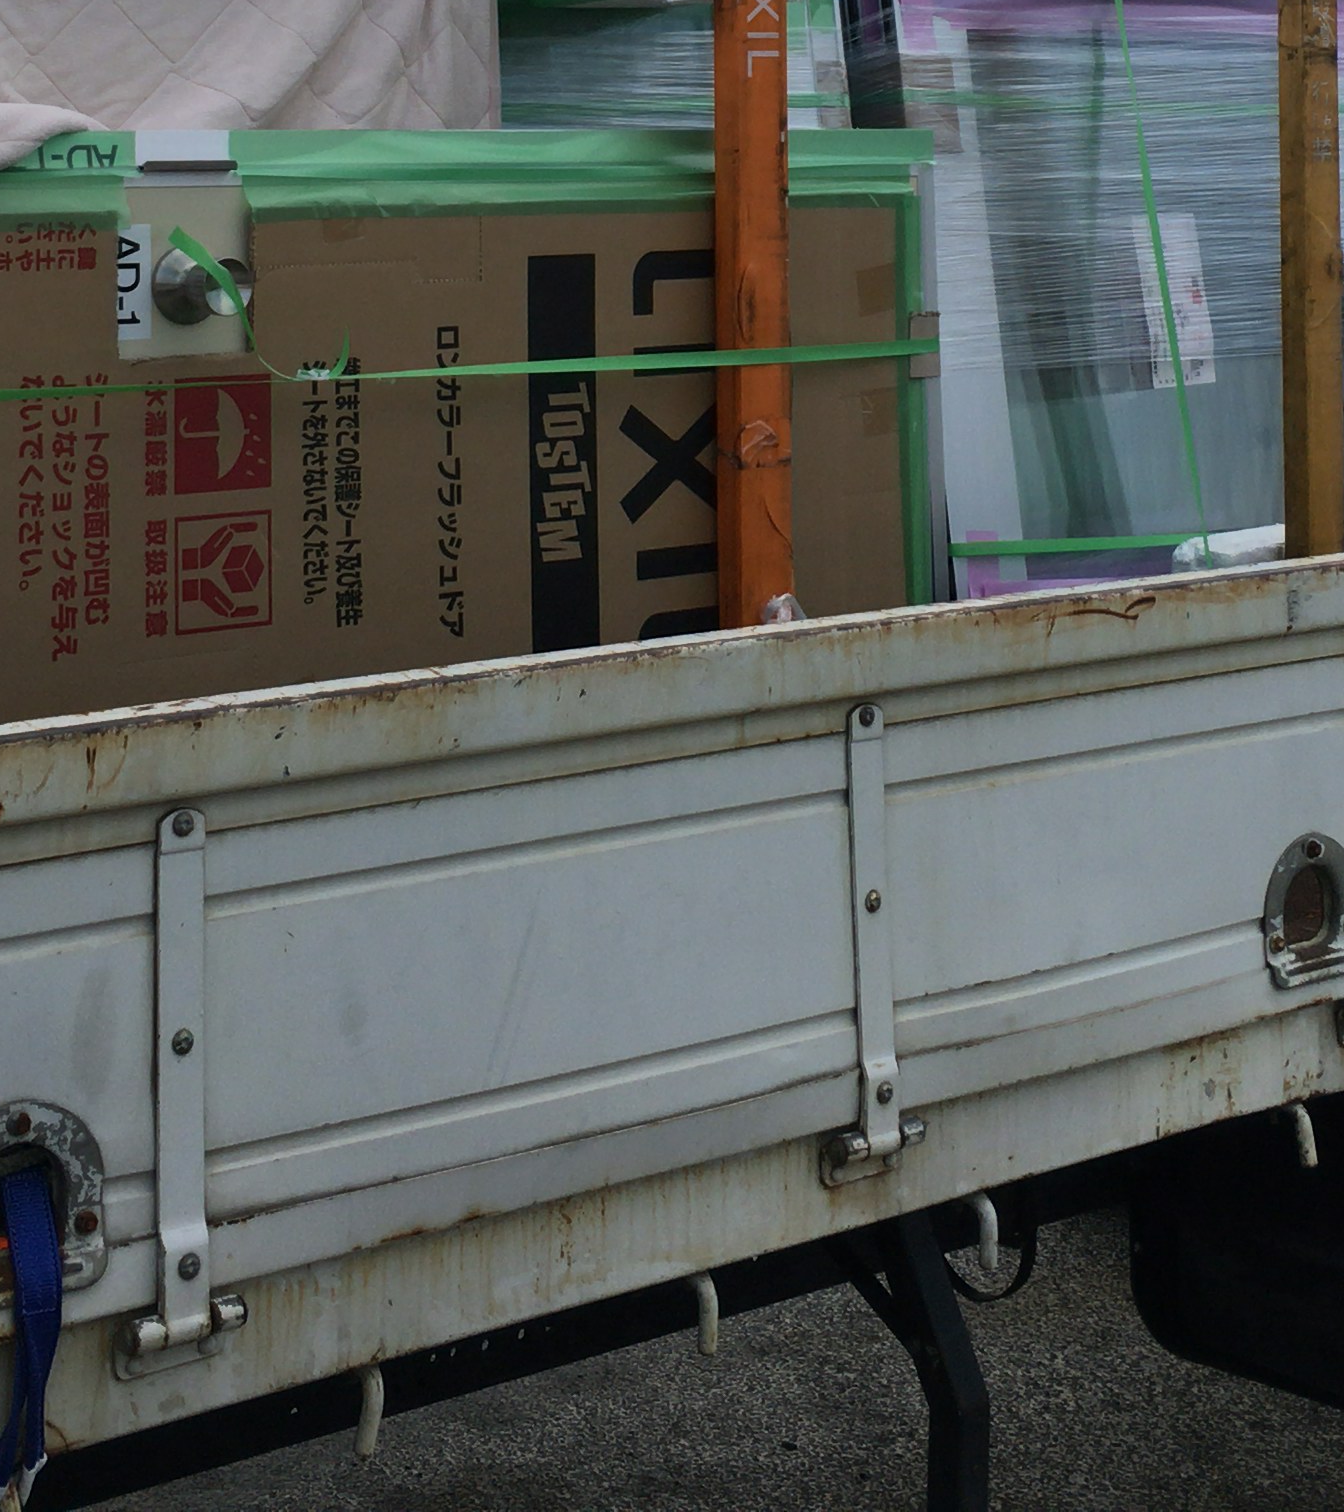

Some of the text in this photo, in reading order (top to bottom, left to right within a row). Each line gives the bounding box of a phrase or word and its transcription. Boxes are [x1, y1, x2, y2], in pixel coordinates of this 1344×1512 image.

[83, 372, 111, 626] シートの表面が凹む
[535, 382, 592, 563] TOSTEM
[144, 518, 169, 638] 取扱注意
